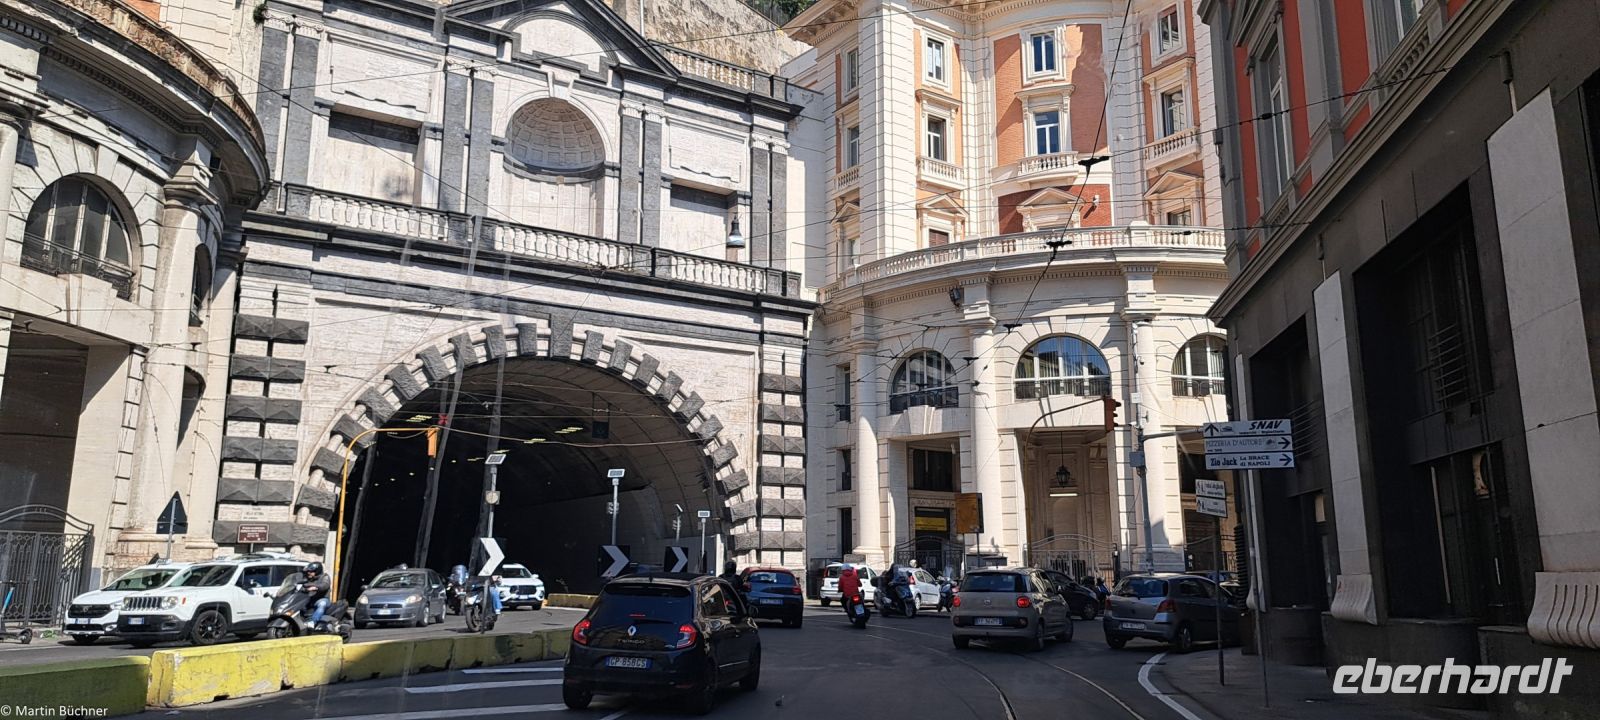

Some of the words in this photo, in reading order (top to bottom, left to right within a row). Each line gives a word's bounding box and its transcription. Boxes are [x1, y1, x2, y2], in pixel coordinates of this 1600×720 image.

[1249, 420, 1282, 430] SNAV
[1210, 458, 1221, 466] Zio
[1222, 457, 1238, 466] Jack
